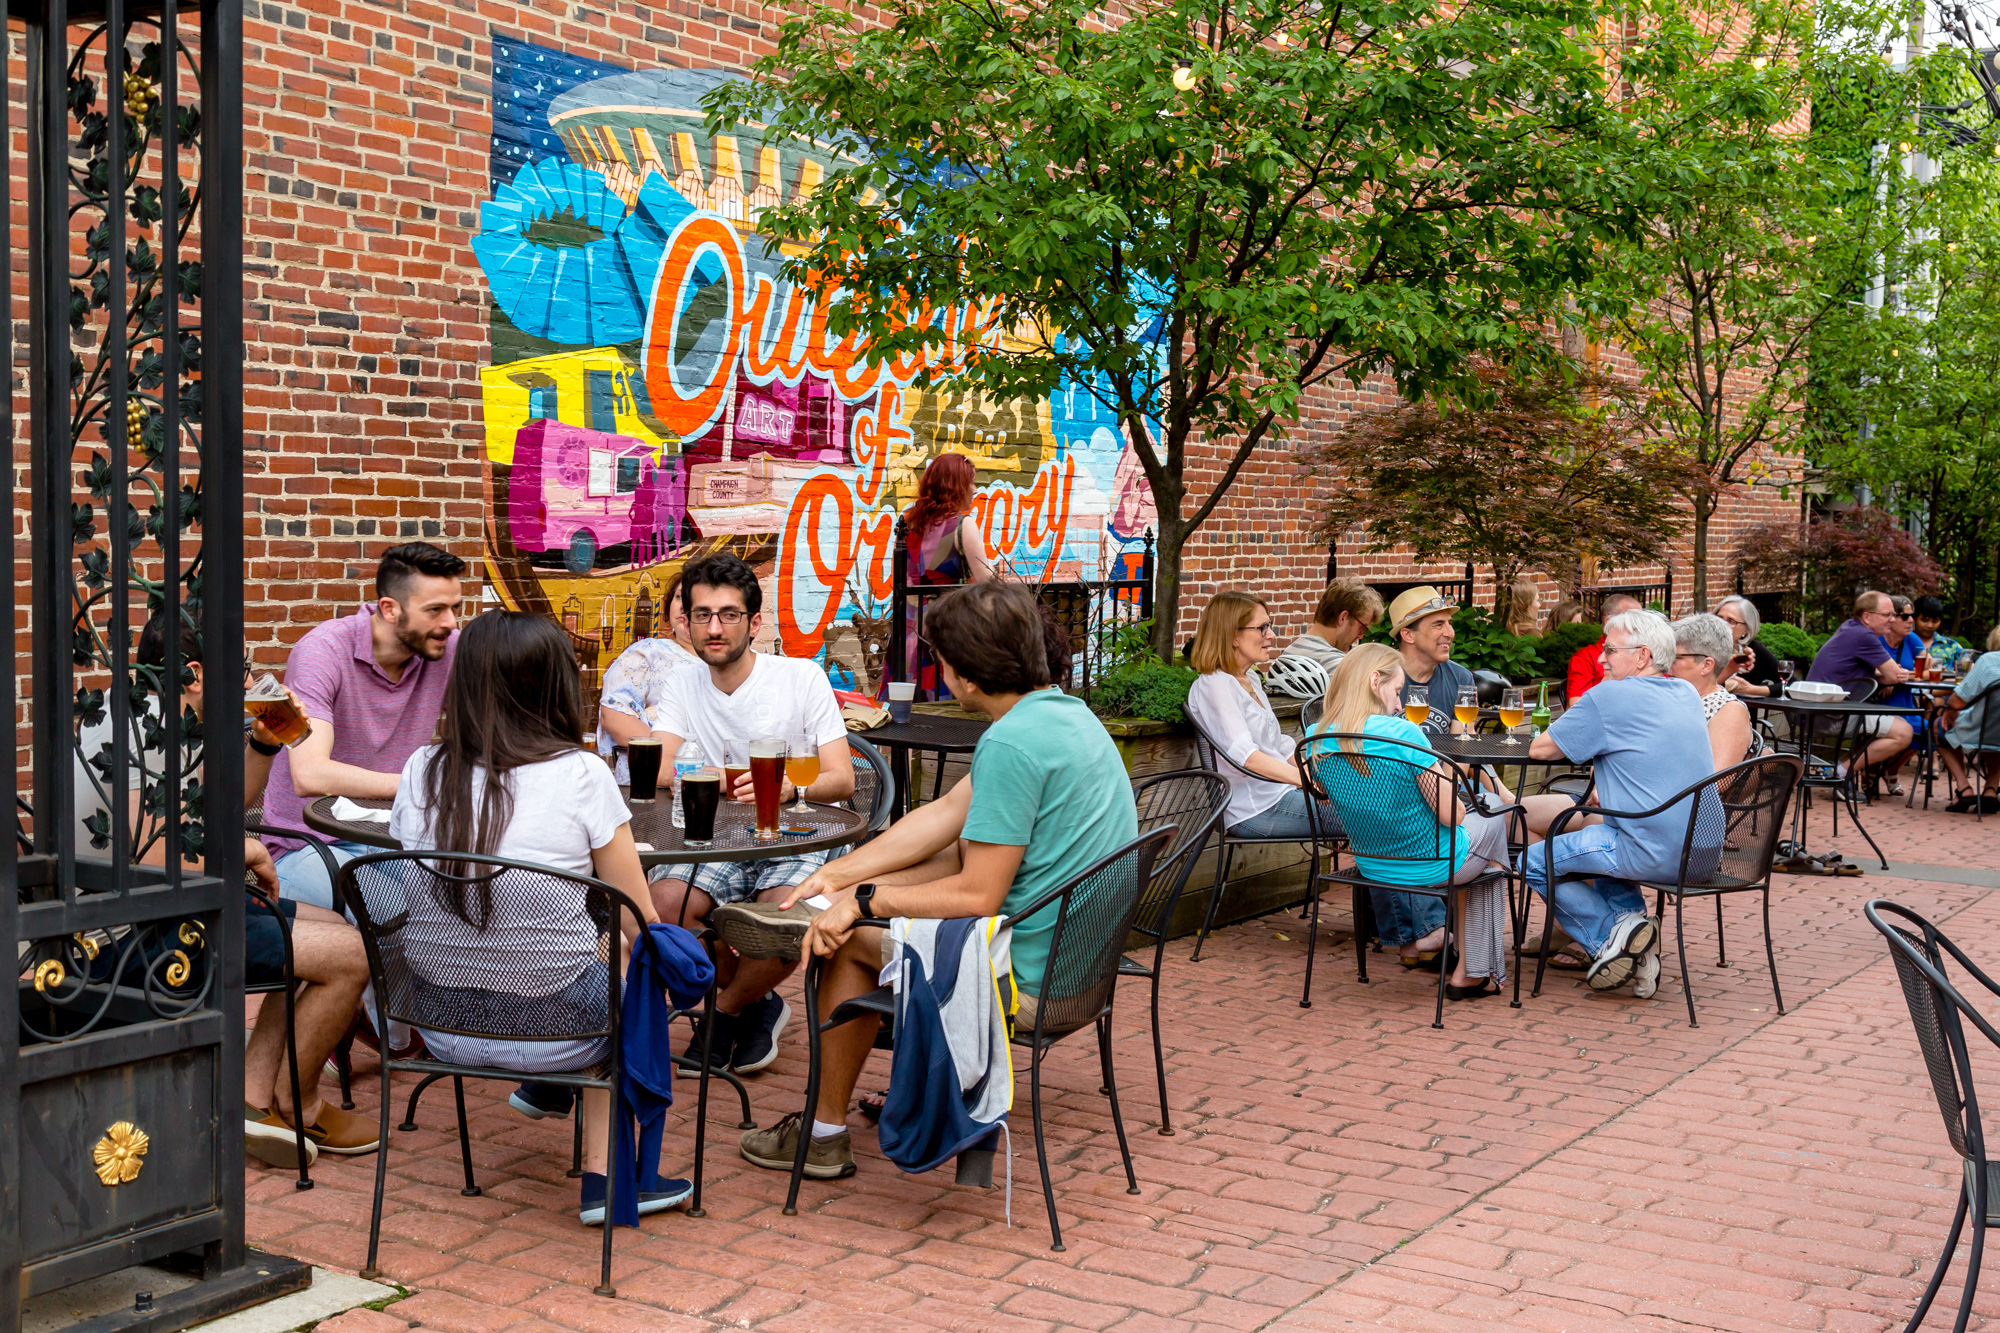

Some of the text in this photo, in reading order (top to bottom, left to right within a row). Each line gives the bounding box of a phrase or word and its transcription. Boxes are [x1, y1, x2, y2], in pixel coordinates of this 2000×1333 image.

[739, 398, 794, 439] ART
[855, 381, 909, 506] of
[712, 490, 735, 500] COUNTY
[776, 453, 1076, 661] Orary
